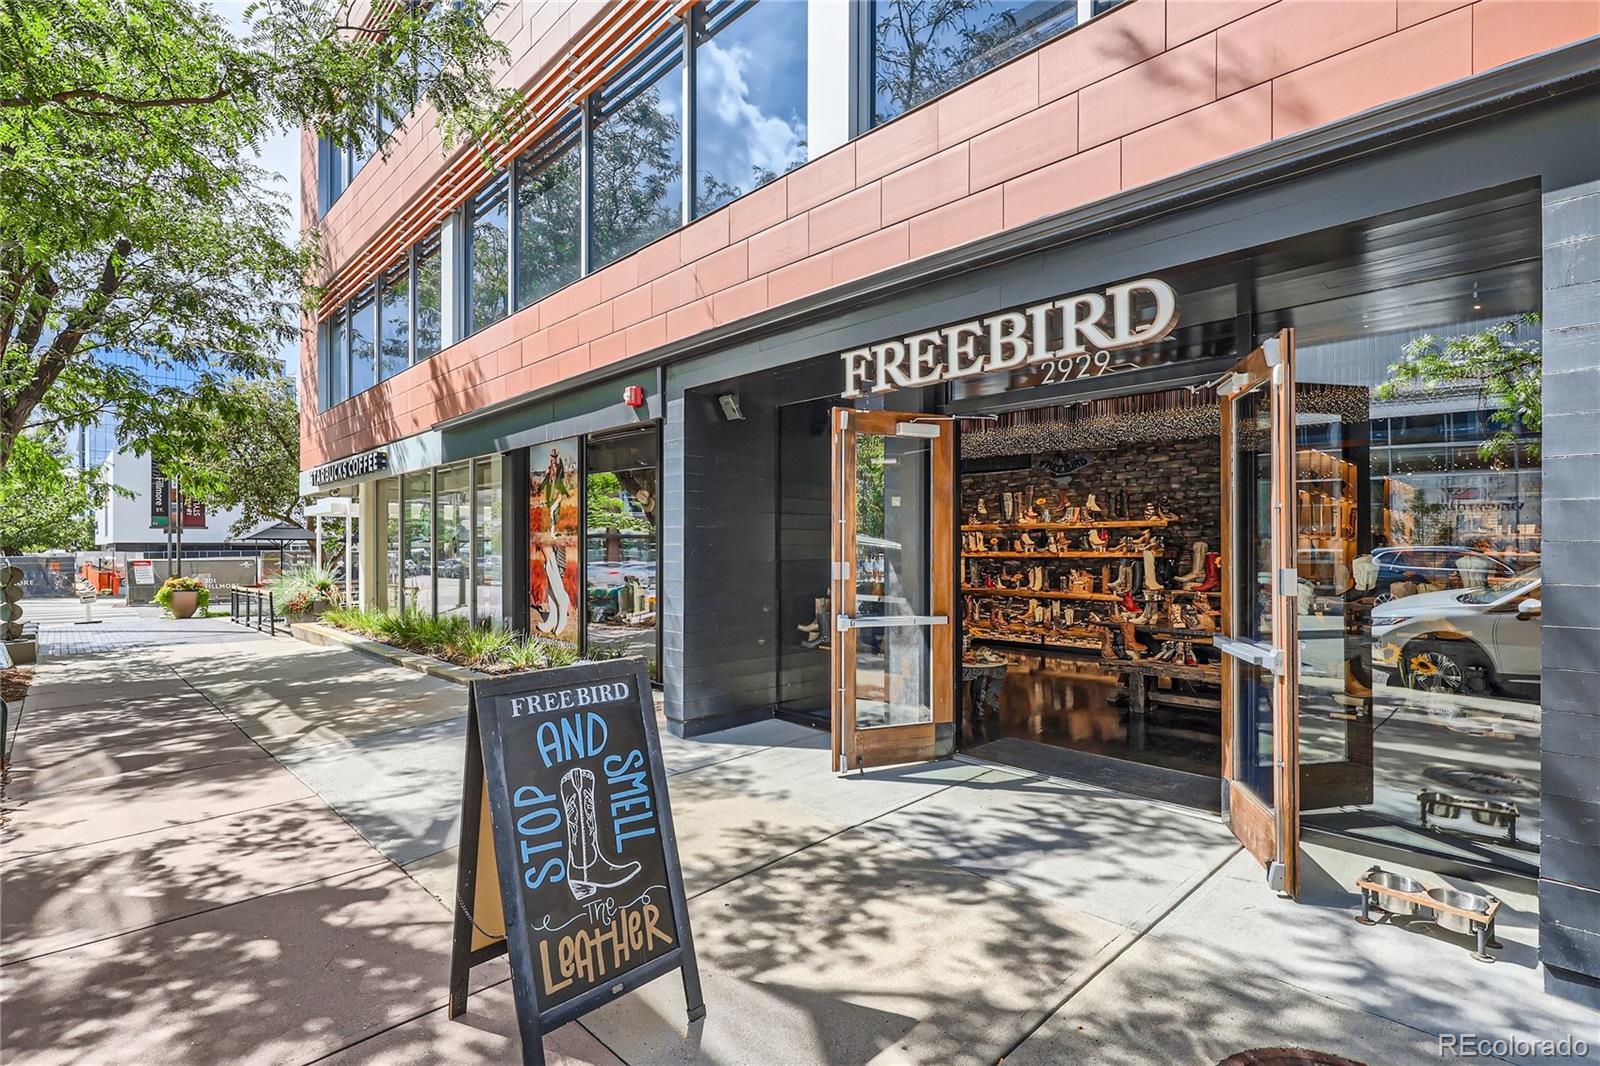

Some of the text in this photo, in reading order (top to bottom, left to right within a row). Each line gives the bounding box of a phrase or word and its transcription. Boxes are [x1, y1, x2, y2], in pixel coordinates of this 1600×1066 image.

[840, 278, 1180, 399] FREEBIRD
[1041, 350, 1111, 385] 2929
[348, 451, 379, 477] COFFEE
[537, 712, 608, 768] AND
[514, 785, 566, 890] STOP
[603, 749, 656, 854] SMELL
